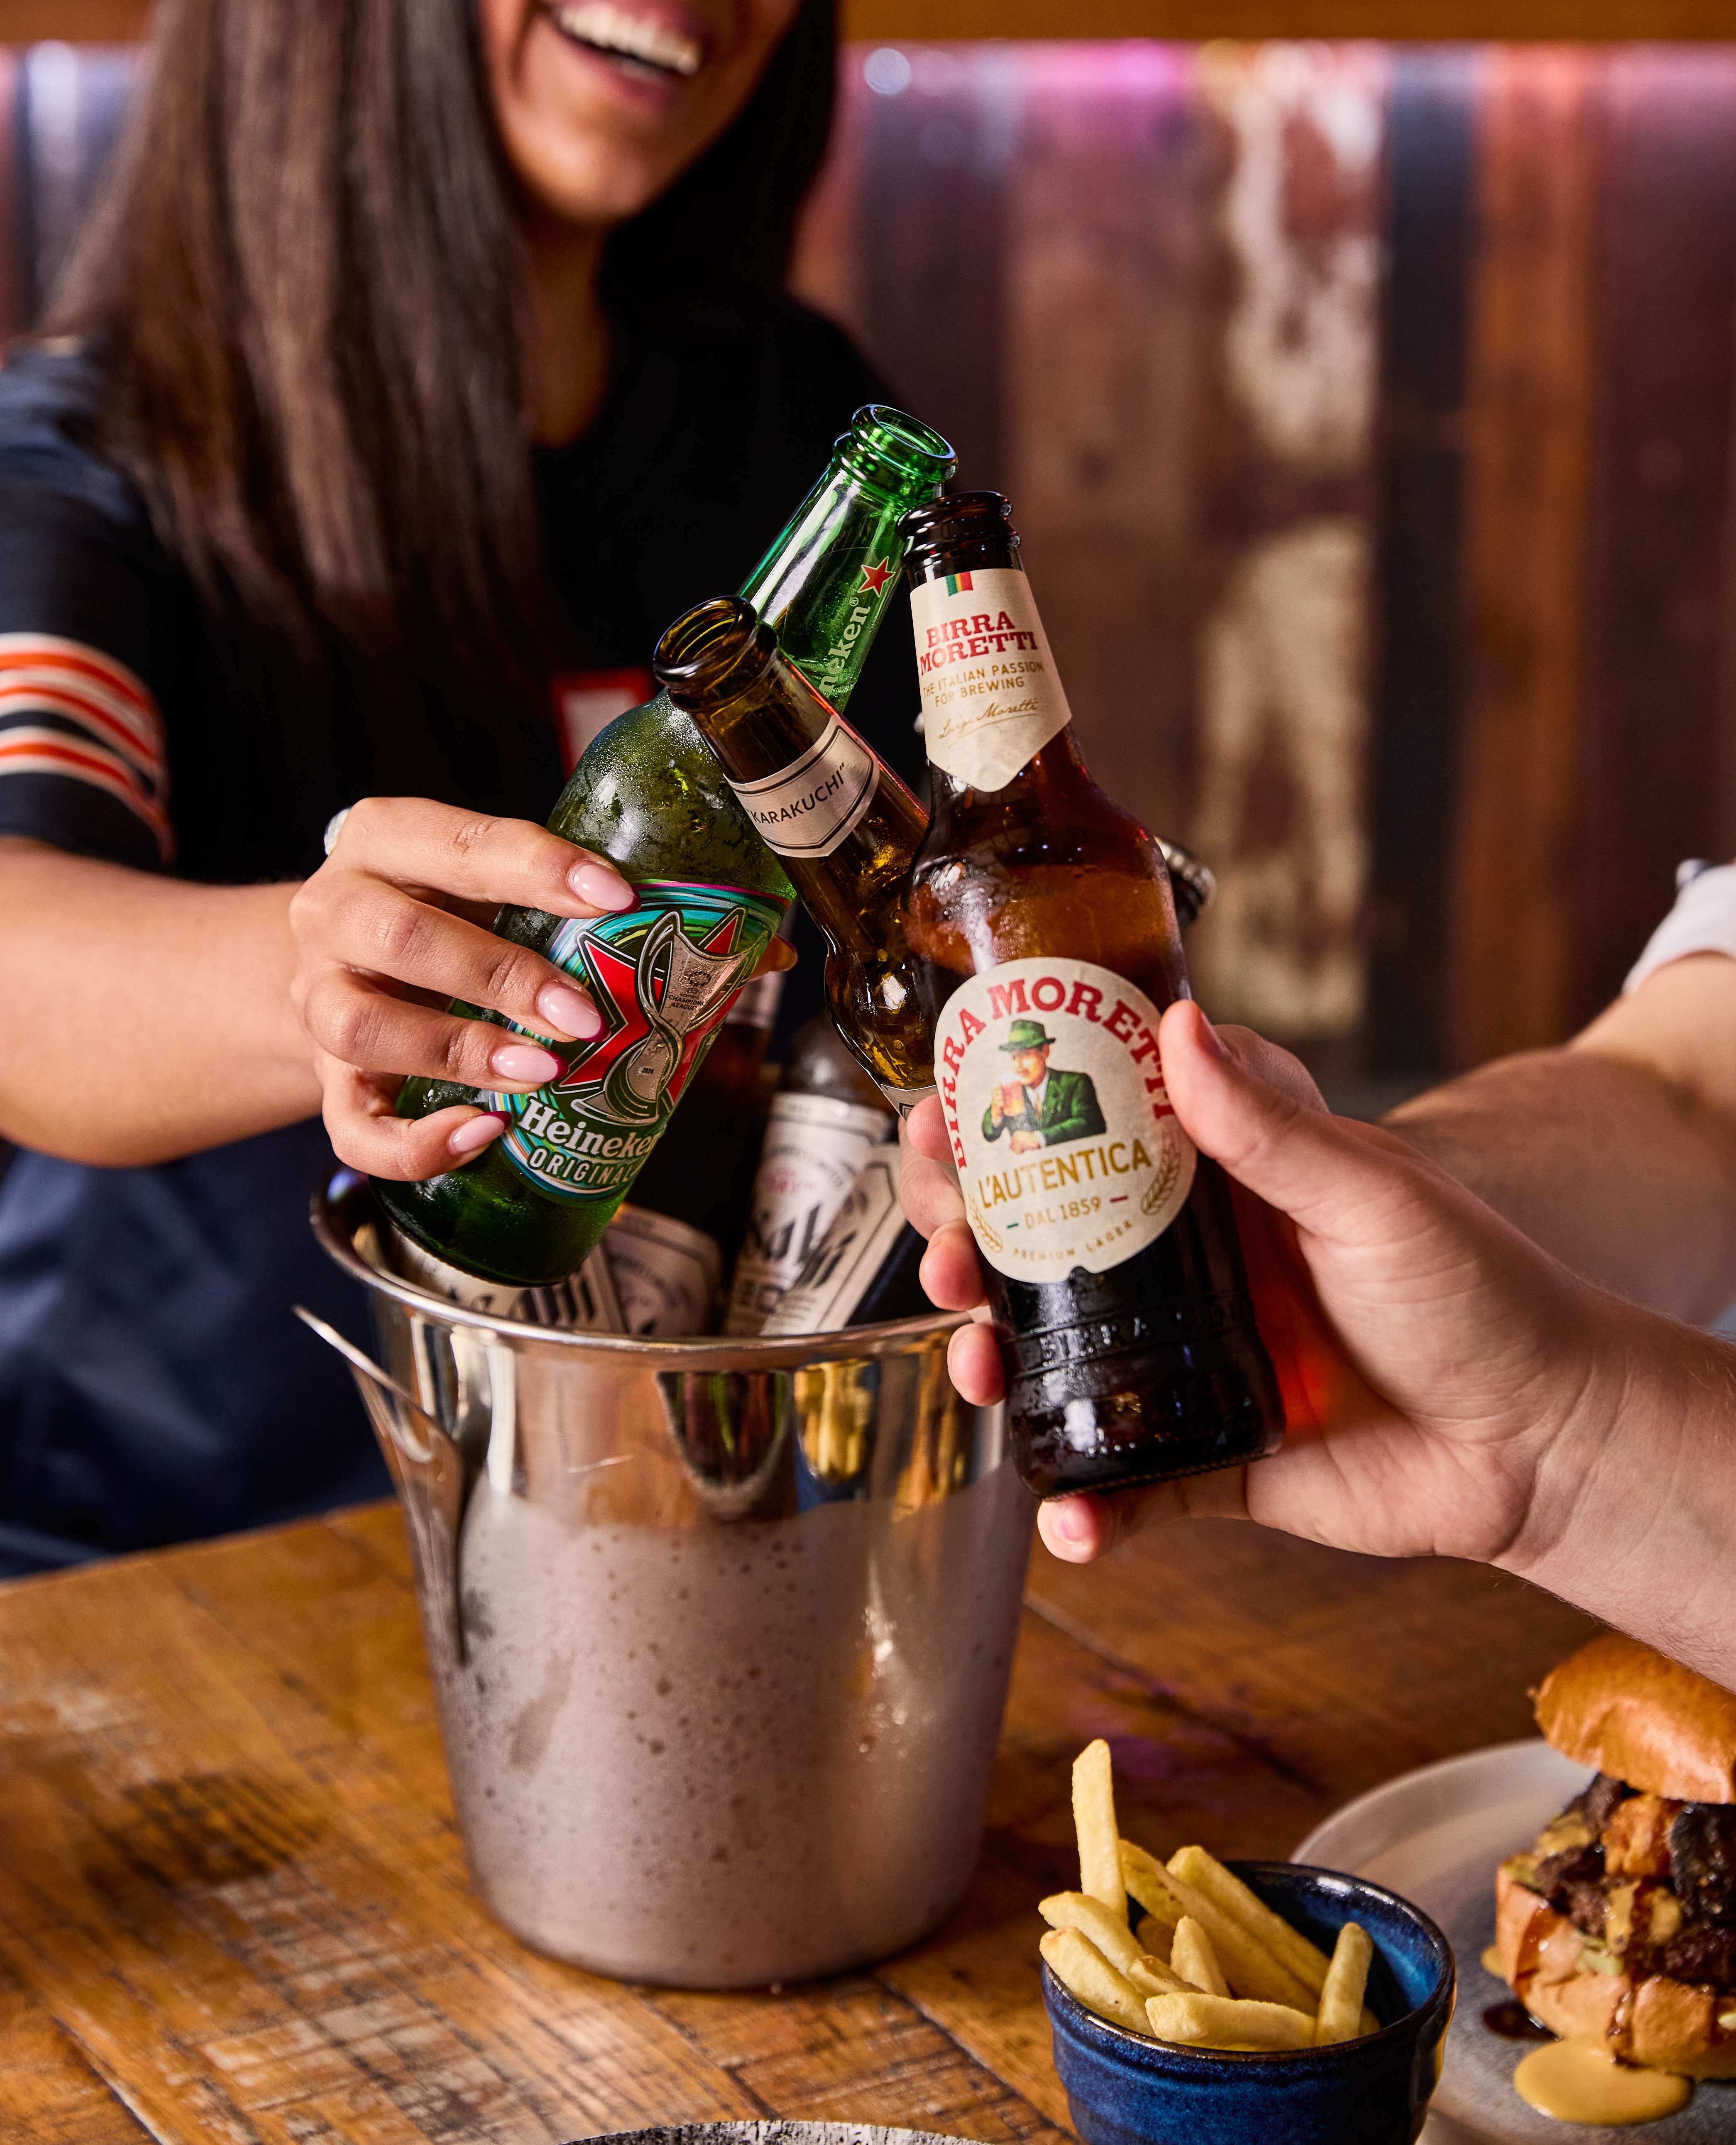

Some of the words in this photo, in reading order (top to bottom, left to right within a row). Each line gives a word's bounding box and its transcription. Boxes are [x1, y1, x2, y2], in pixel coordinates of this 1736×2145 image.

[819, 597, 870, 698] neken®
[926, 611, 1015, 648] BIRRA
[920, 631, 1038, 676] MORETTI
[923, 683, 934, 699] THE
[938, 668, 985, 690] ITALIAN
[991, 661, 1044, 676] PASSION
[935, 691, 954, 707] FOR
[960, 676, 1025, 698] BREWING
[939, 710, 975, 740] Luigi
[977, 697, 1039, 721] Moretti
[668, 995, 705, 1006] CHAMPIONS
[672, 1002, 695, 1010] LEAGUE
[943, 1008, 986, 1169] BIRRA
[529, 1148, 633, 1184] ORIGINAL
[978, 1139, 1152, 1209] L'AUTENTICA
[1024, 1208, 1056, 1229] DAL
[1059, 1196, 1101, 1220] 1859
[1012, 1247, 1076, 1262] PREMIUM
[1085, 1219, 1133, 1252] LAGER
